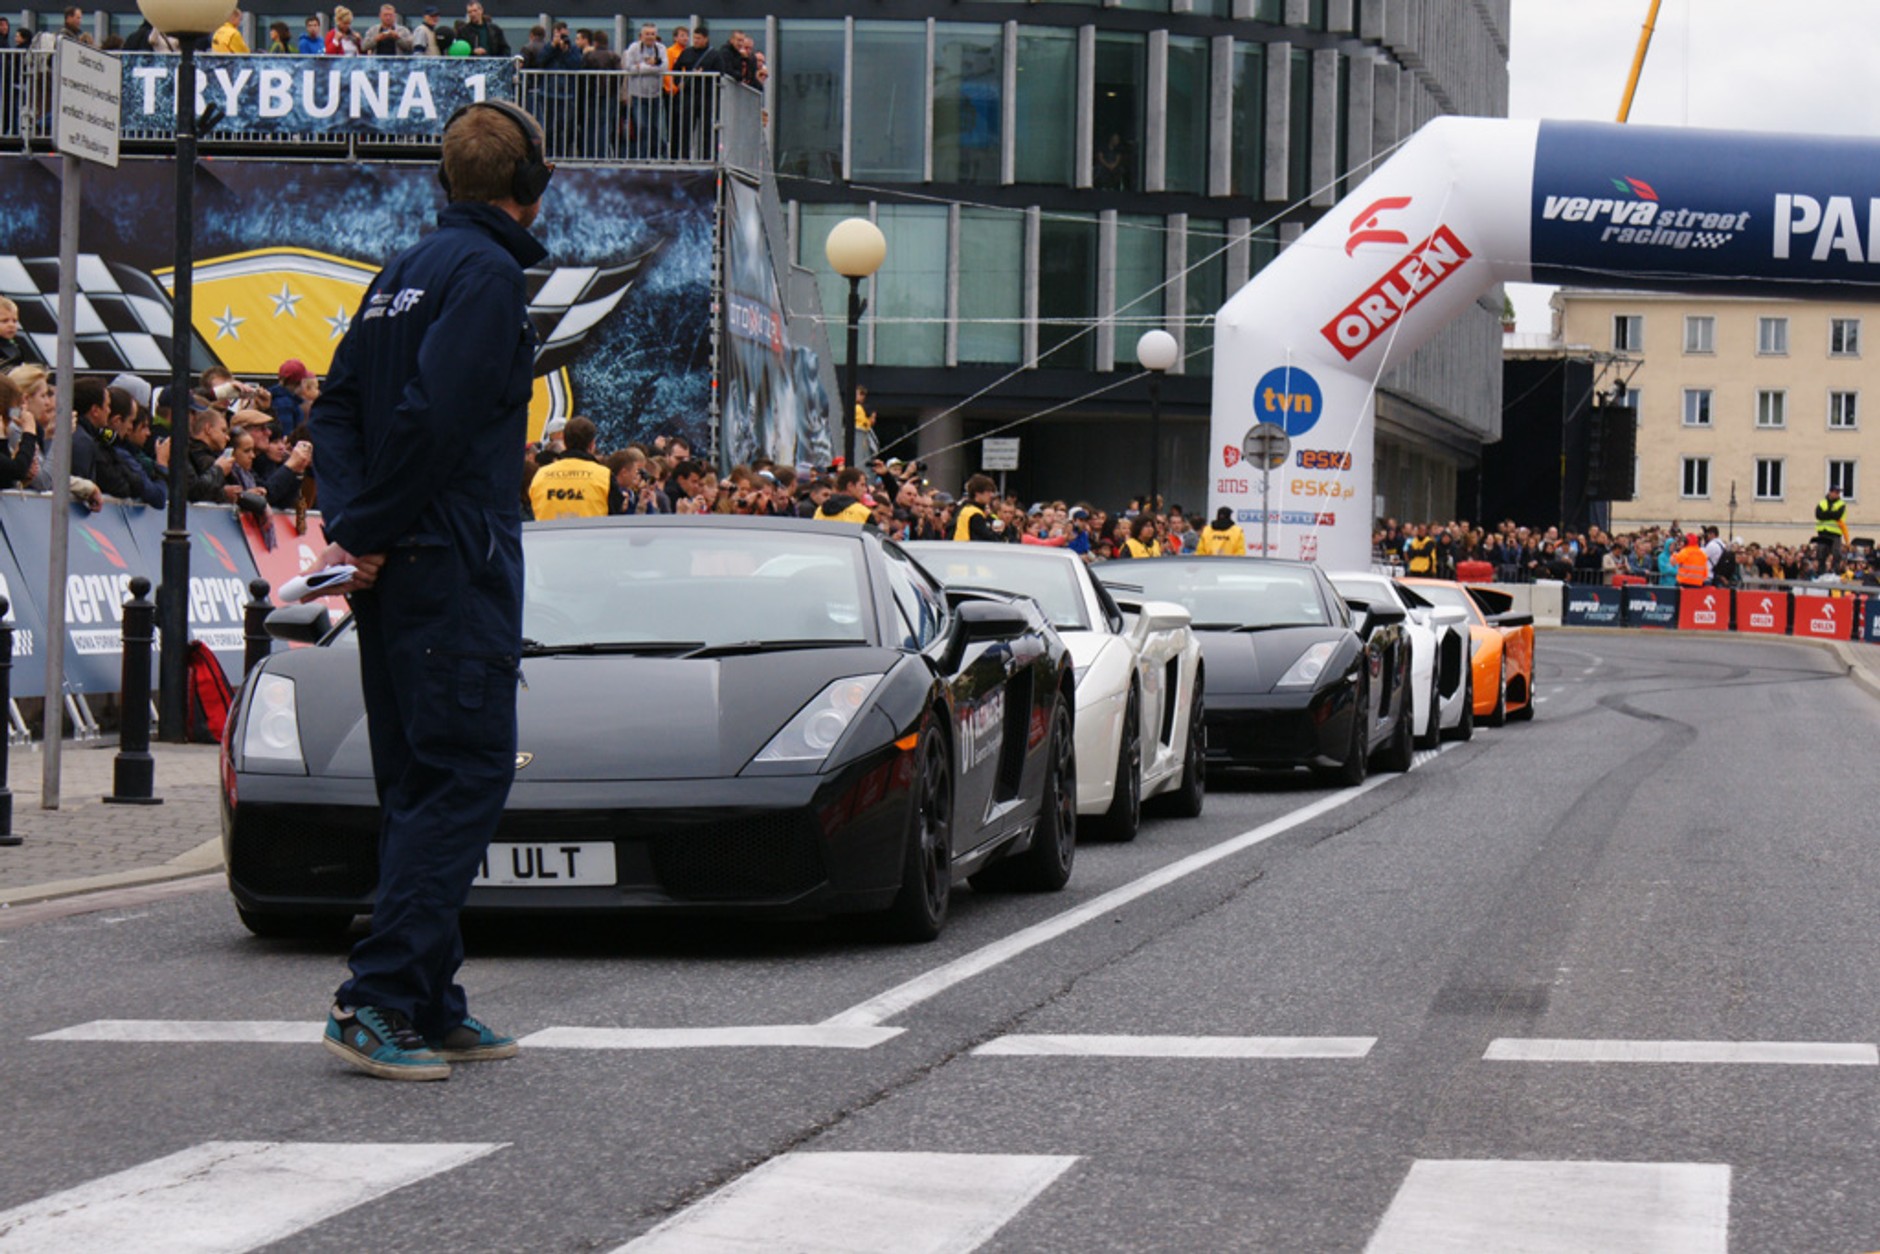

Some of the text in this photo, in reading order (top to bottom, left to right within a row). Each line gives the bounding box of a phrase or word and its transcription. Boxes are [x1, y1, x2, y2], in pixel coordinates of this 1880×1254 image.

[132, 67, 438, 119] TRYBUNA
[1542, 195, 1750, 231] verva street
[1601, 225, 1694, 250] racing
[1336, 235, 1462, 348] ORLEN
[1263, 387, 1312, 413] tvn
[1301, 450, 1352, 470] eska
[544, 470, 593, 478] SECURITY
[1217, 479, 1249, 494] ams
[512, 846, 581, 879] ULT
